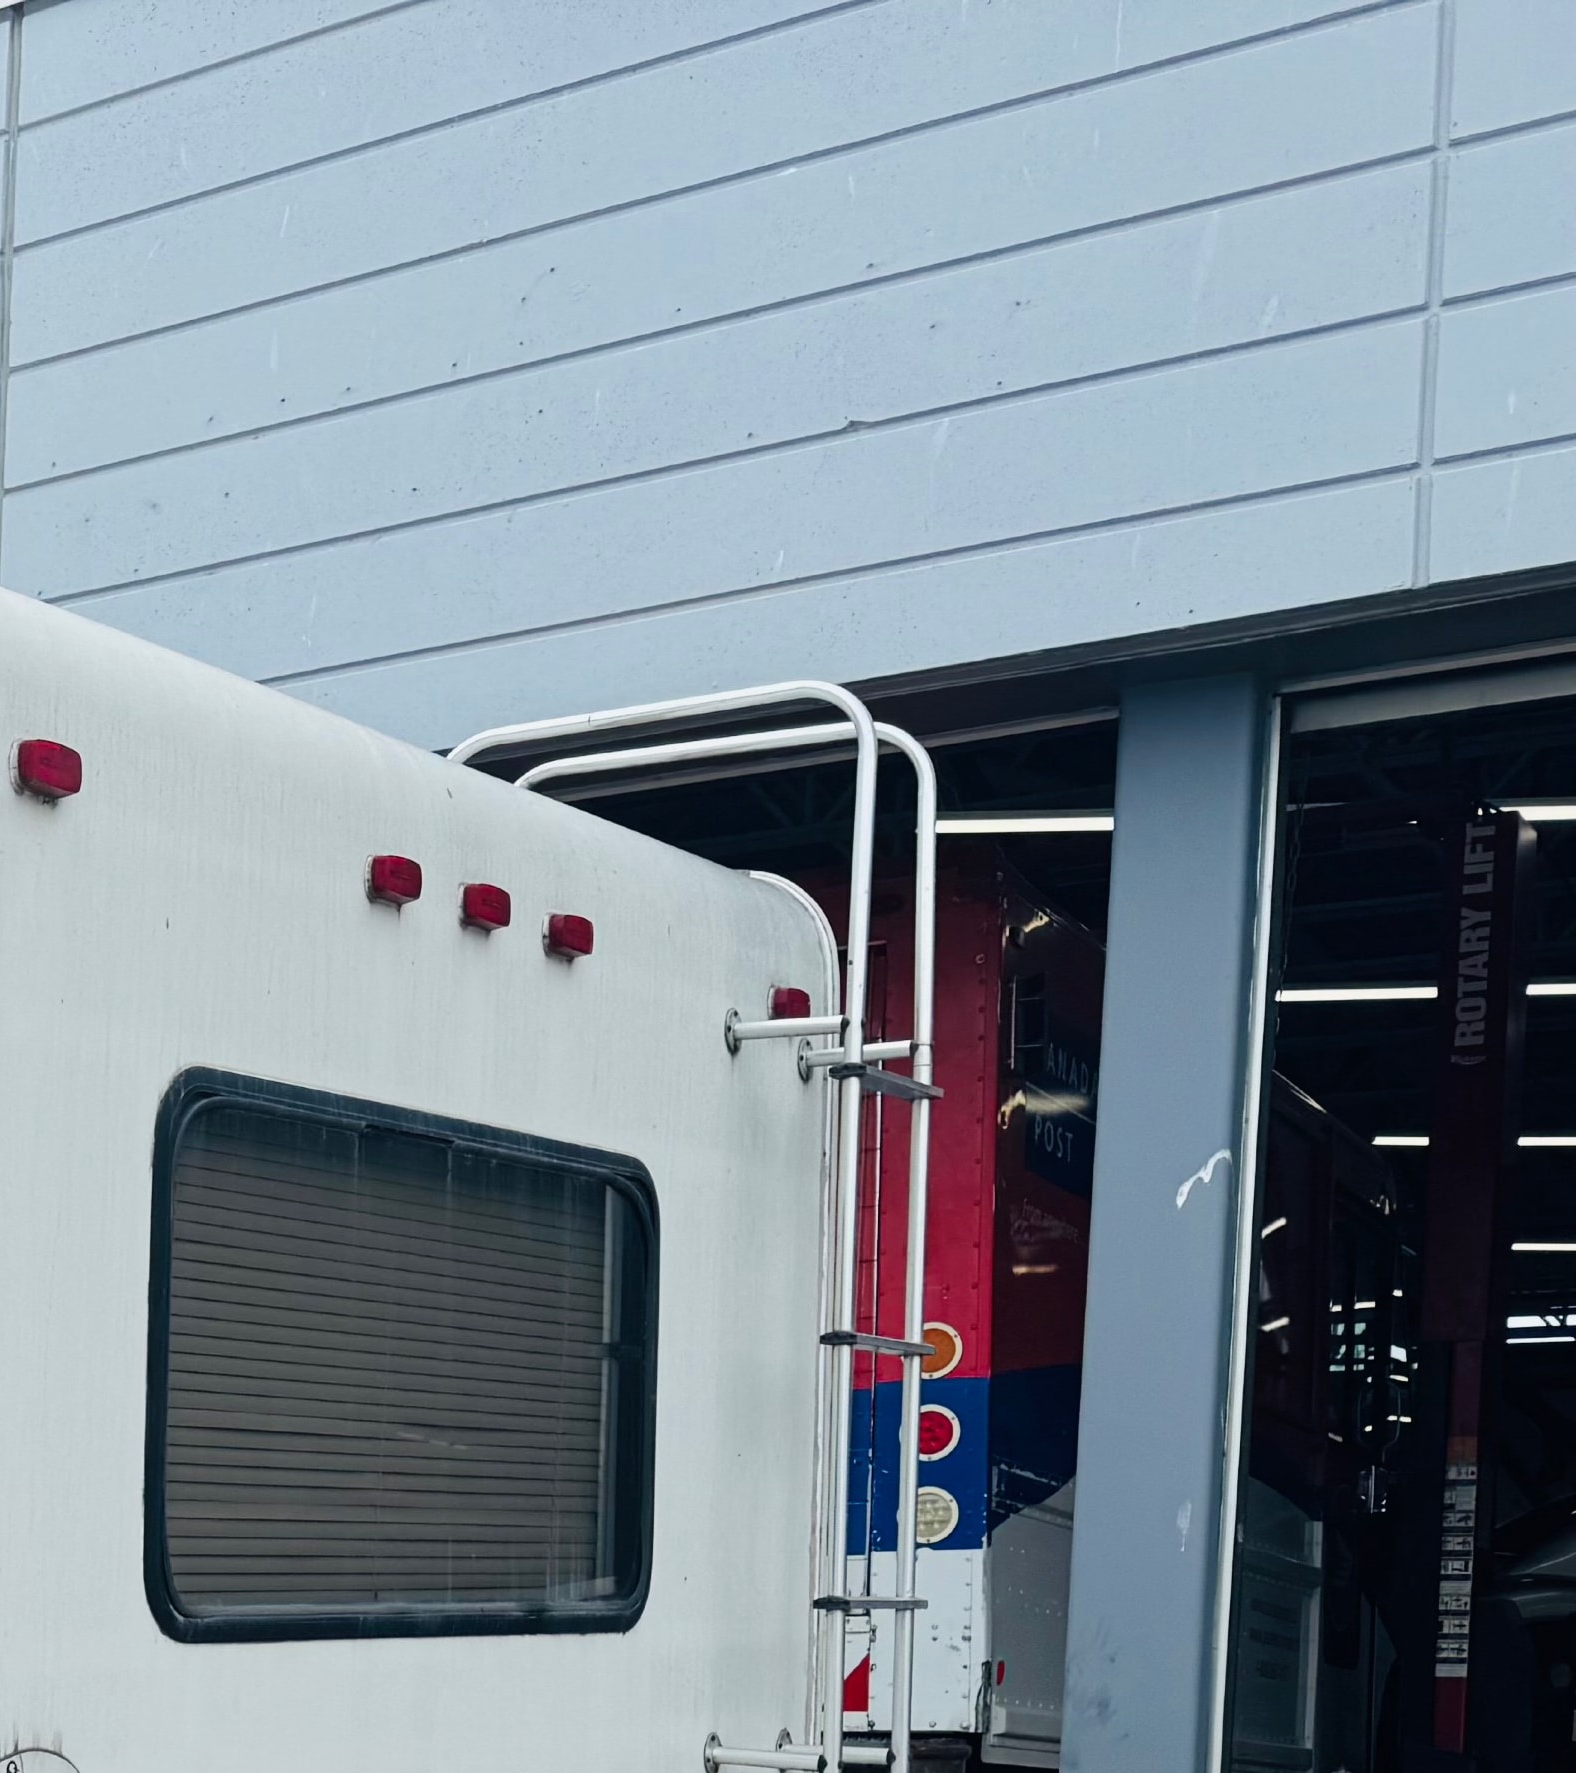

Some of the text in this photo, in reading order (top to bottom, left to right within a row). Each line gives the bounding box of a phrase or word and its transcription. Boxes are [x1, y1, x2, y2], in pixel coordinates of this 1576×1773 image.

[1462, 822, 1496, 895] LIFT
[1454, 907, 1492, 1046] ROTARY
[1034, 1113, 1073, 1163] POST
